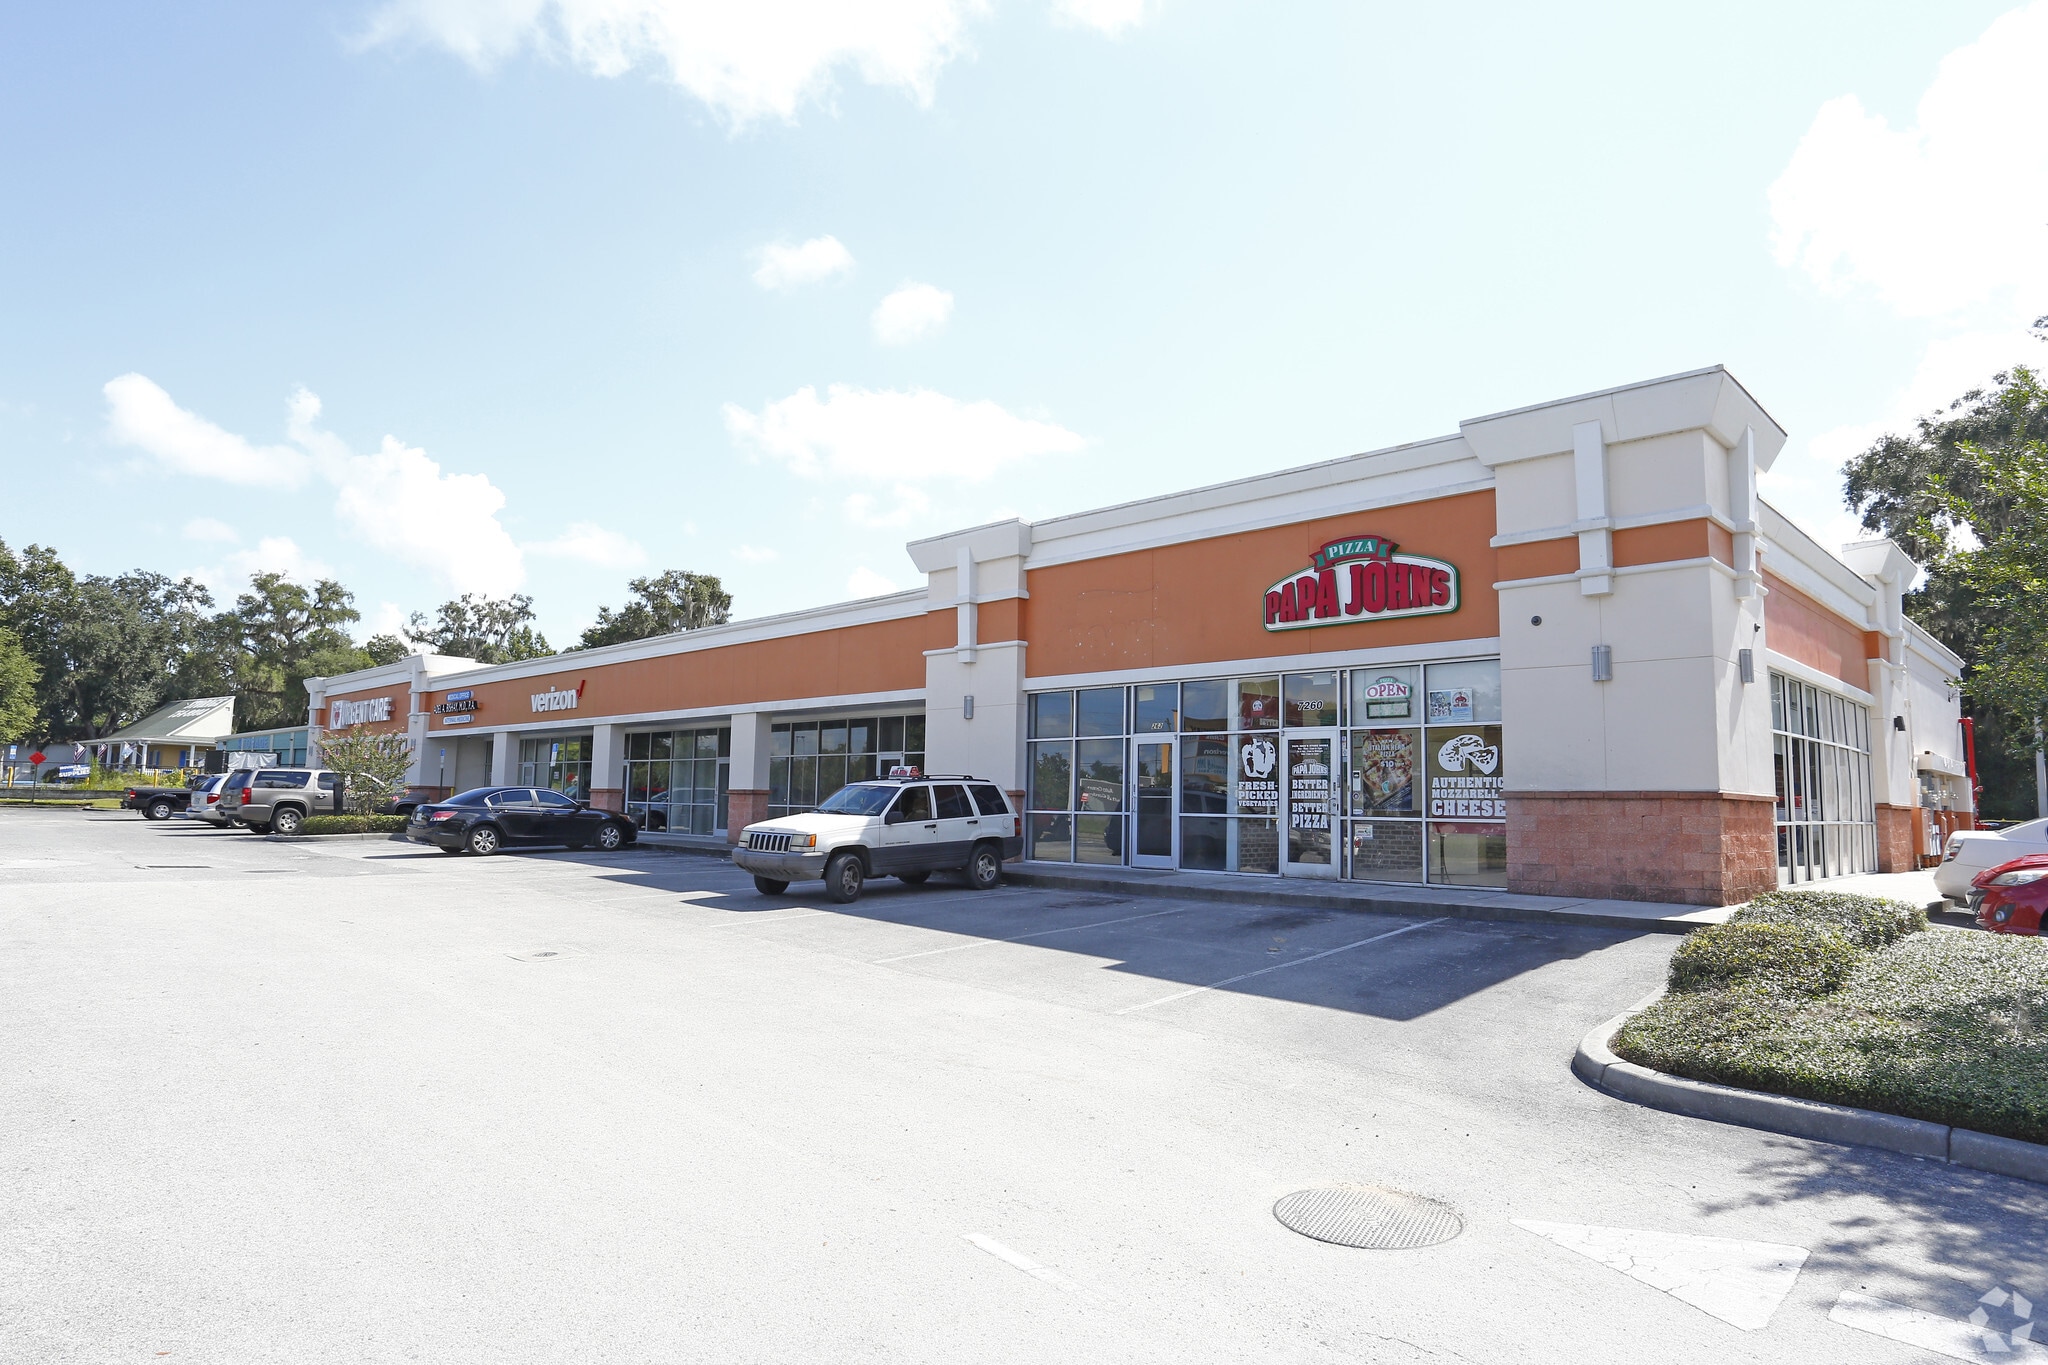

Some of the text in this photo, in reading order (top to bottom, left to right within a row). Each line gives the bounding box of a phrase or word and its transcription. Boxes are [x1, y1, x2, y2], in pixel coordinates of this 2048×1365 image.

[1328, 540, 1374, 559] PIZZA
[1265, 568, 1341, 624] PAPA
[1366, 683, 1408, 698] OPEN
[530, 686, 578, 713] verizon
[368, 697, 392, 723] CARE
[1297, 700, 1323, 711] 7260
[1293, 764, 1308, 774] PAPA
[1380, 760, 1395, 768] $10
[1238, 781, 1278, 790] FRESH-
[1292, 779, 1328, 790] BETTER
[1431, 776, 1504, 788] AUTHENTIC
[1238, 790, 1278, 800] PICKED
[1292, 790, 1329, 799] INGREDIENTS
[1431, 788, 1503, 799] MOZZARELL
[1292, 802, 1328, 813] BETTER
[1431, 799, 1506, 817] CHEESE
[1292, 814, 1329, 828] PIZZA
